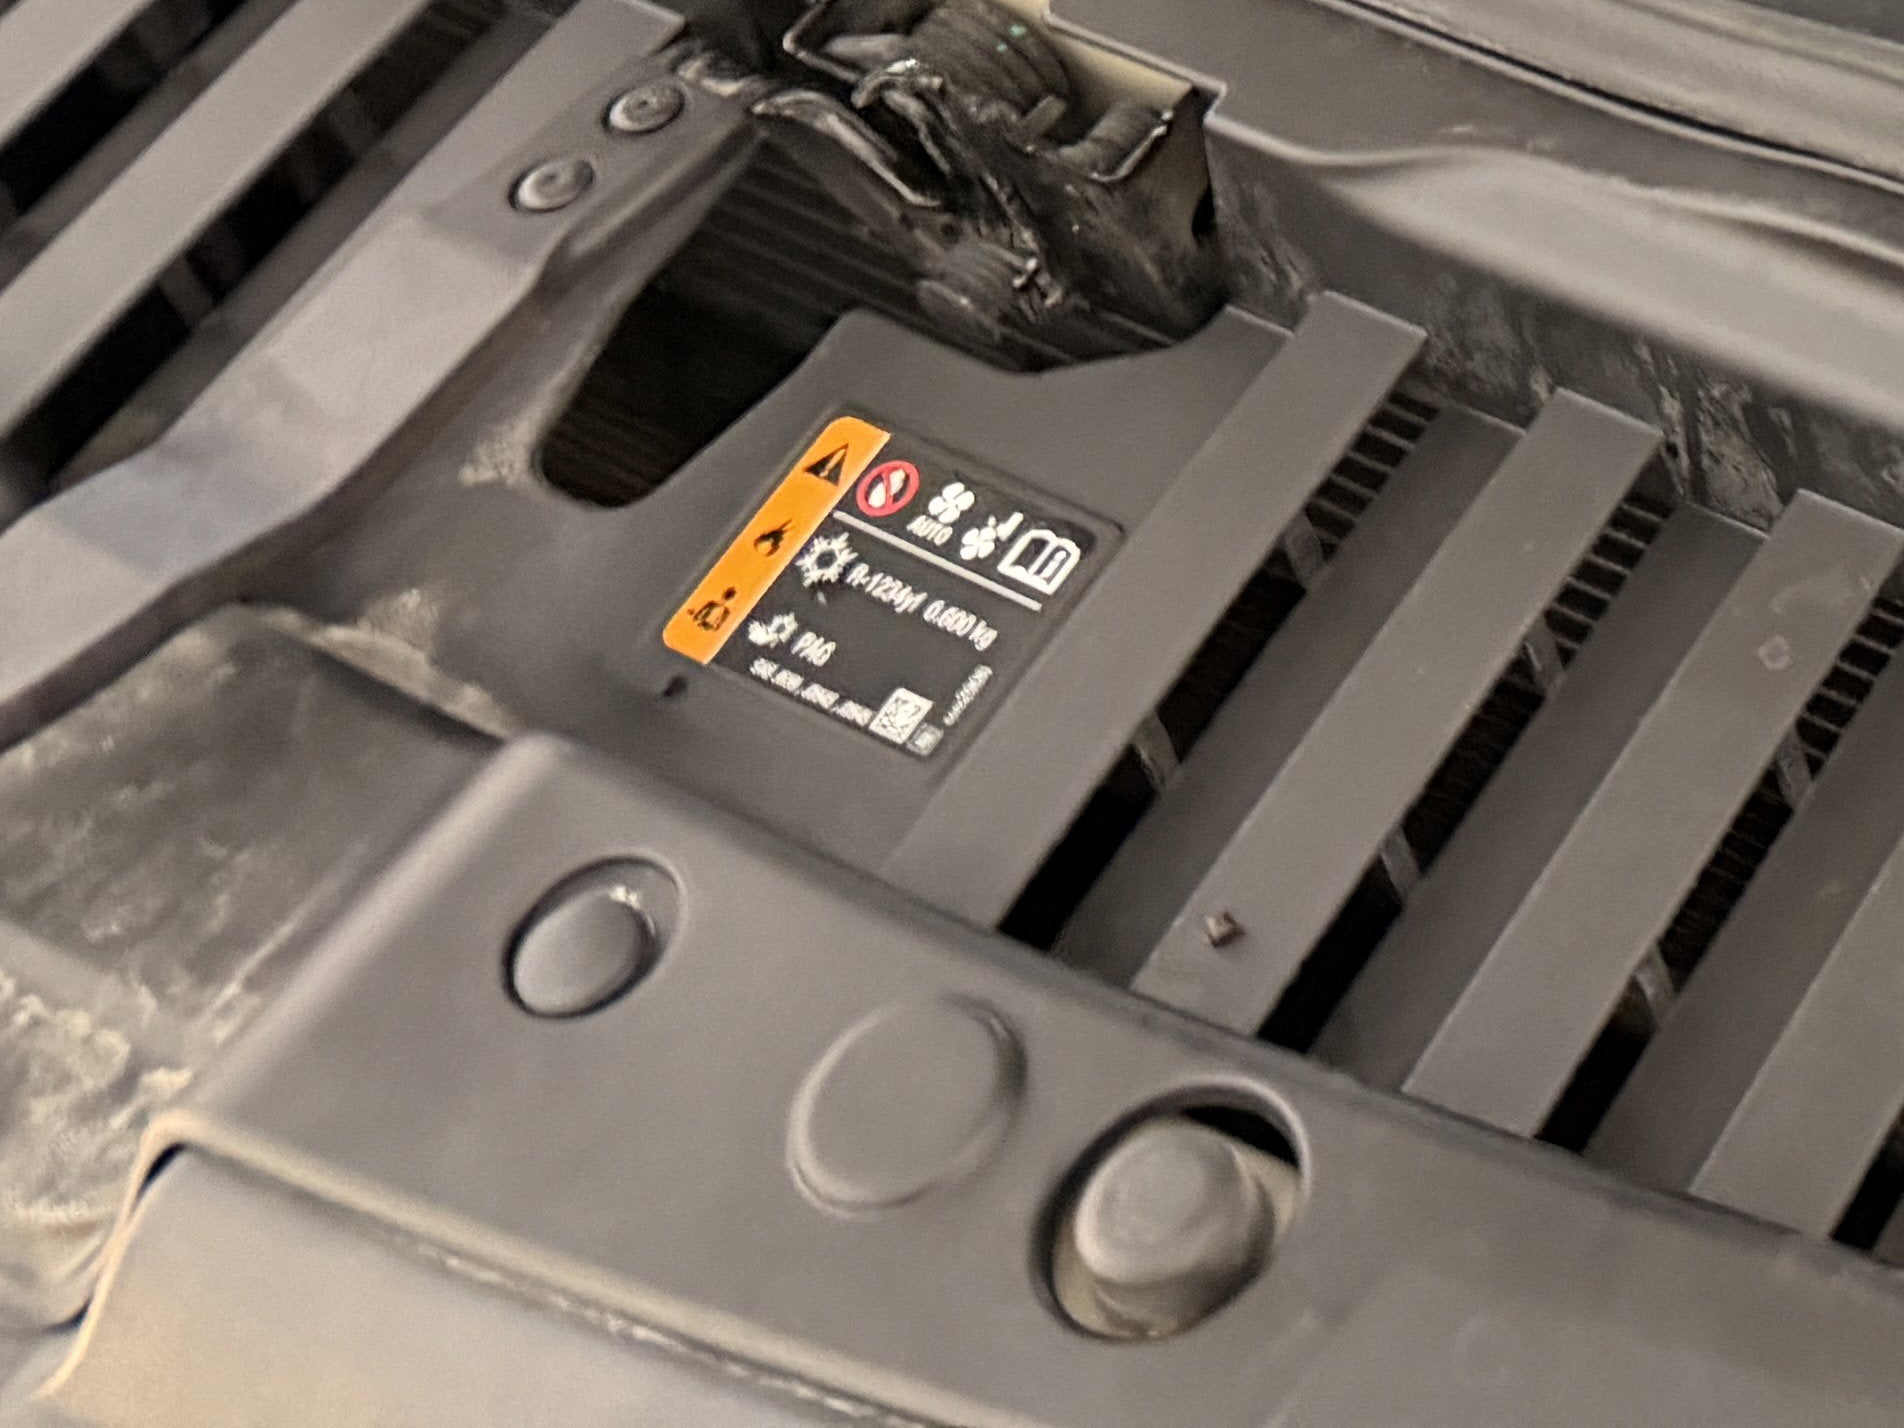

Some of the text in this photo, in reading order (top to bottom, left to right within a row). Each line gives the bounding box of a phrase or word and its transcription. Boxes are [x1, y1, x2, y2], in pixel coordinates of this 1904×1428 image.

[907, 515, 953, 545] AUTO
[924, 599, 977, 636] 0.600
[970, 621, 998, 651] kg
[793, 630, 837, 667] PAG
